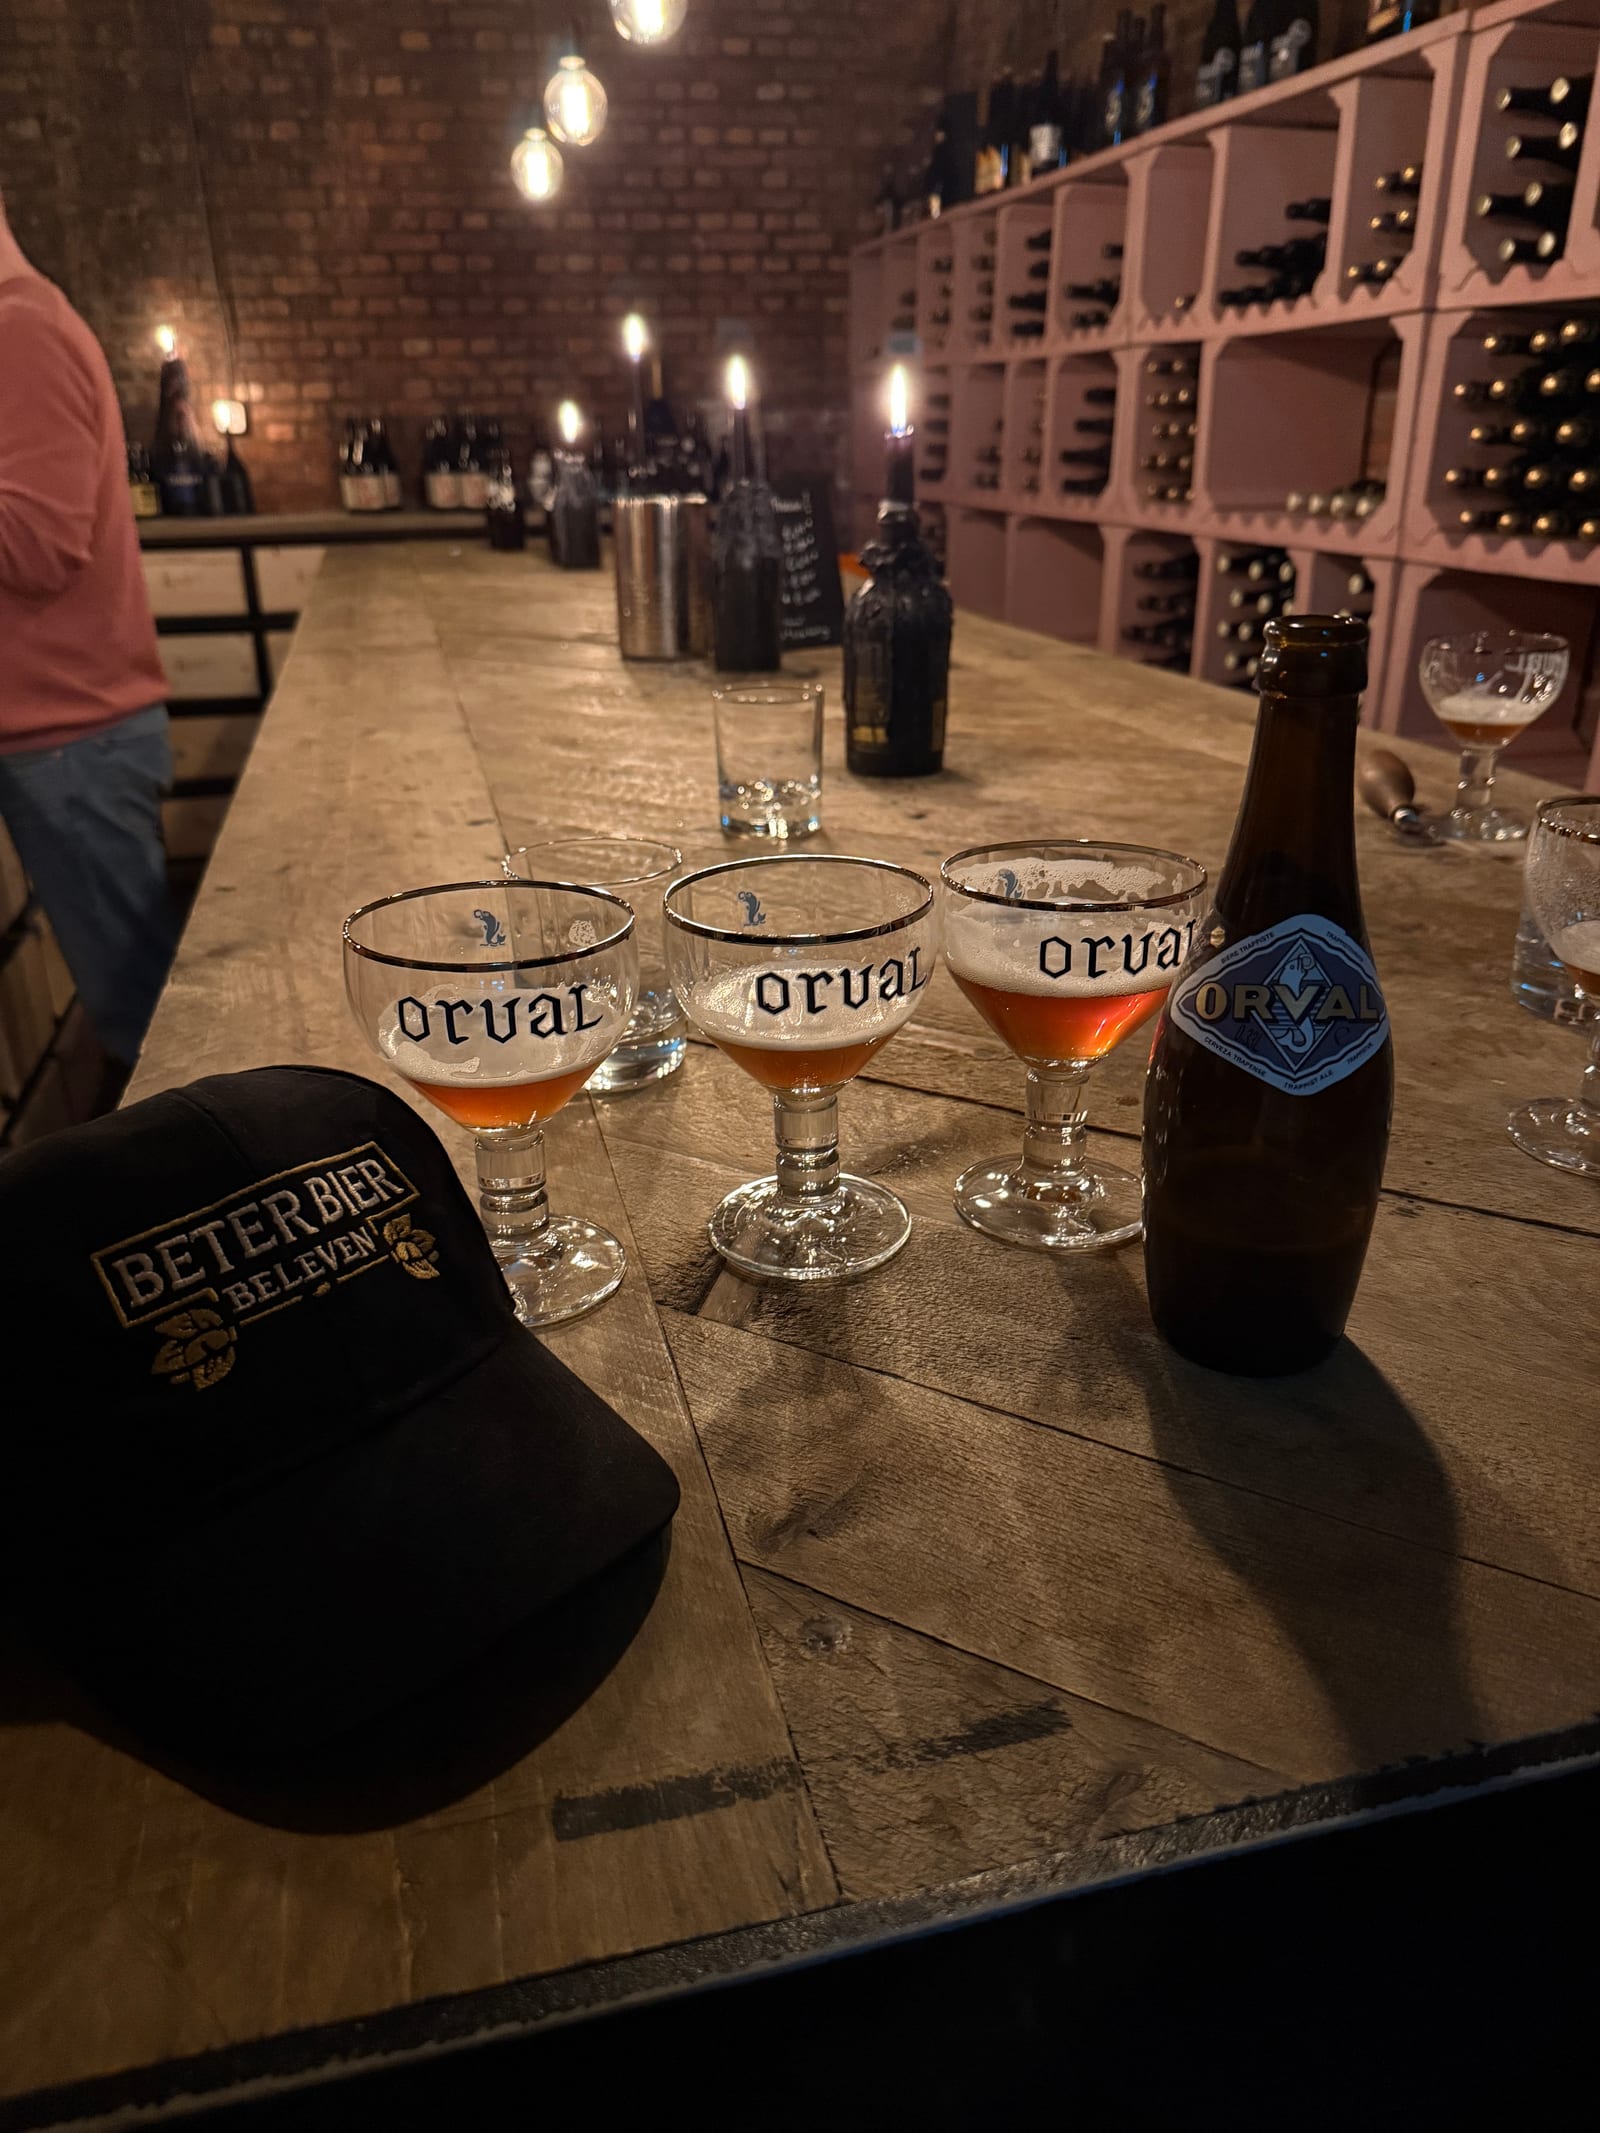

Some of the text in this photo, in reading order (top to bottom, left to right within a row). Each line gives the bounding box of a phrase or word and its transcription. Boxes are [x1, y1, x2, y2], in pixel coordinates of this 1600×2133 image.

[1195, 982, 1381, 1024] ORVAL
[1203, 1036, 1233, 1057] CERVEZA
[1318, 1069, 1334, 1082] ALE
[111, 1158, 405, 1308] BETER BIER
[221, 1226, 378, 1313] BELEVEN
